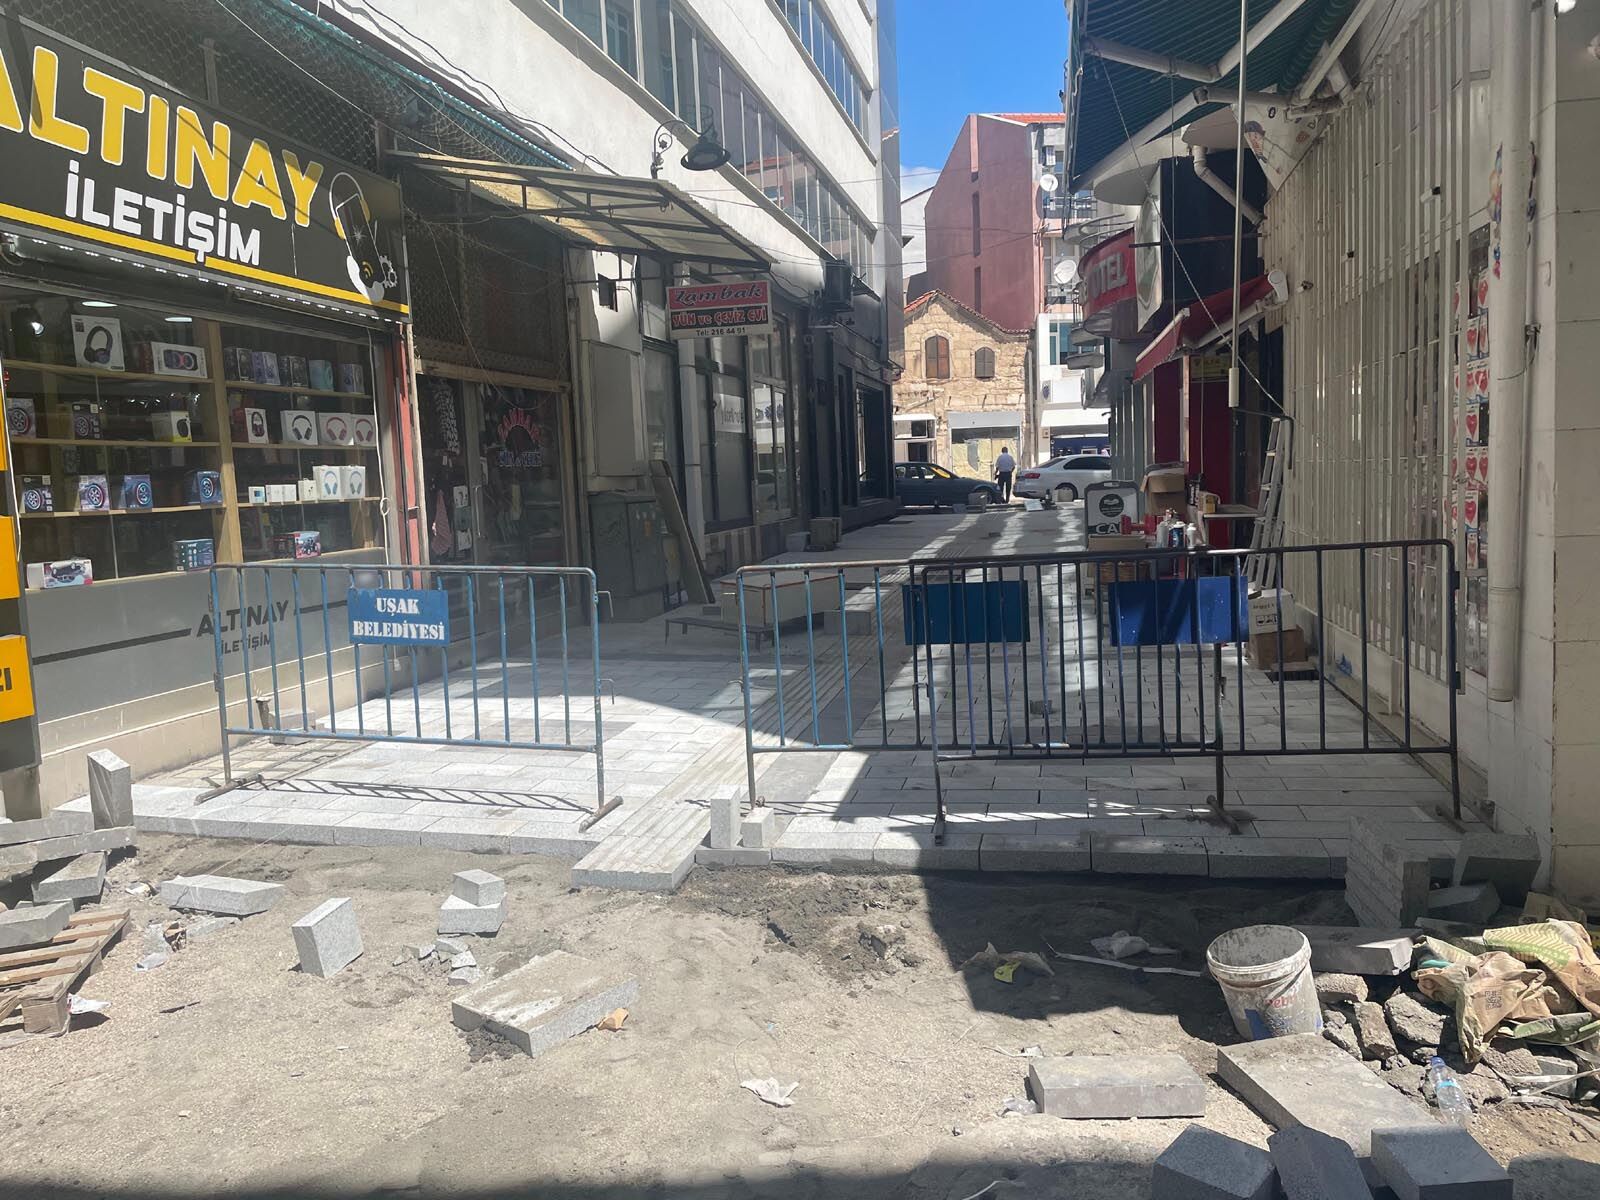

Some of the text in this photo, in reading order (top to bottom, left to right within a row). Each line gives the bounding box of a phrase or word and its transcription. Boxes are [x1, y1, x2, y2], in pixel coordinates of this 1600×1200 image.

[65, 159, 261, 266] İLETİŞİM
[676, 284, 763, 306] Zambak
[672, 312, 696, 327] YÜN
[747, 306, 767, 322] EVİ
[375, 597, 420, 617] UŞAK
[353, 619, 445, 640] BELEDİYESİ
